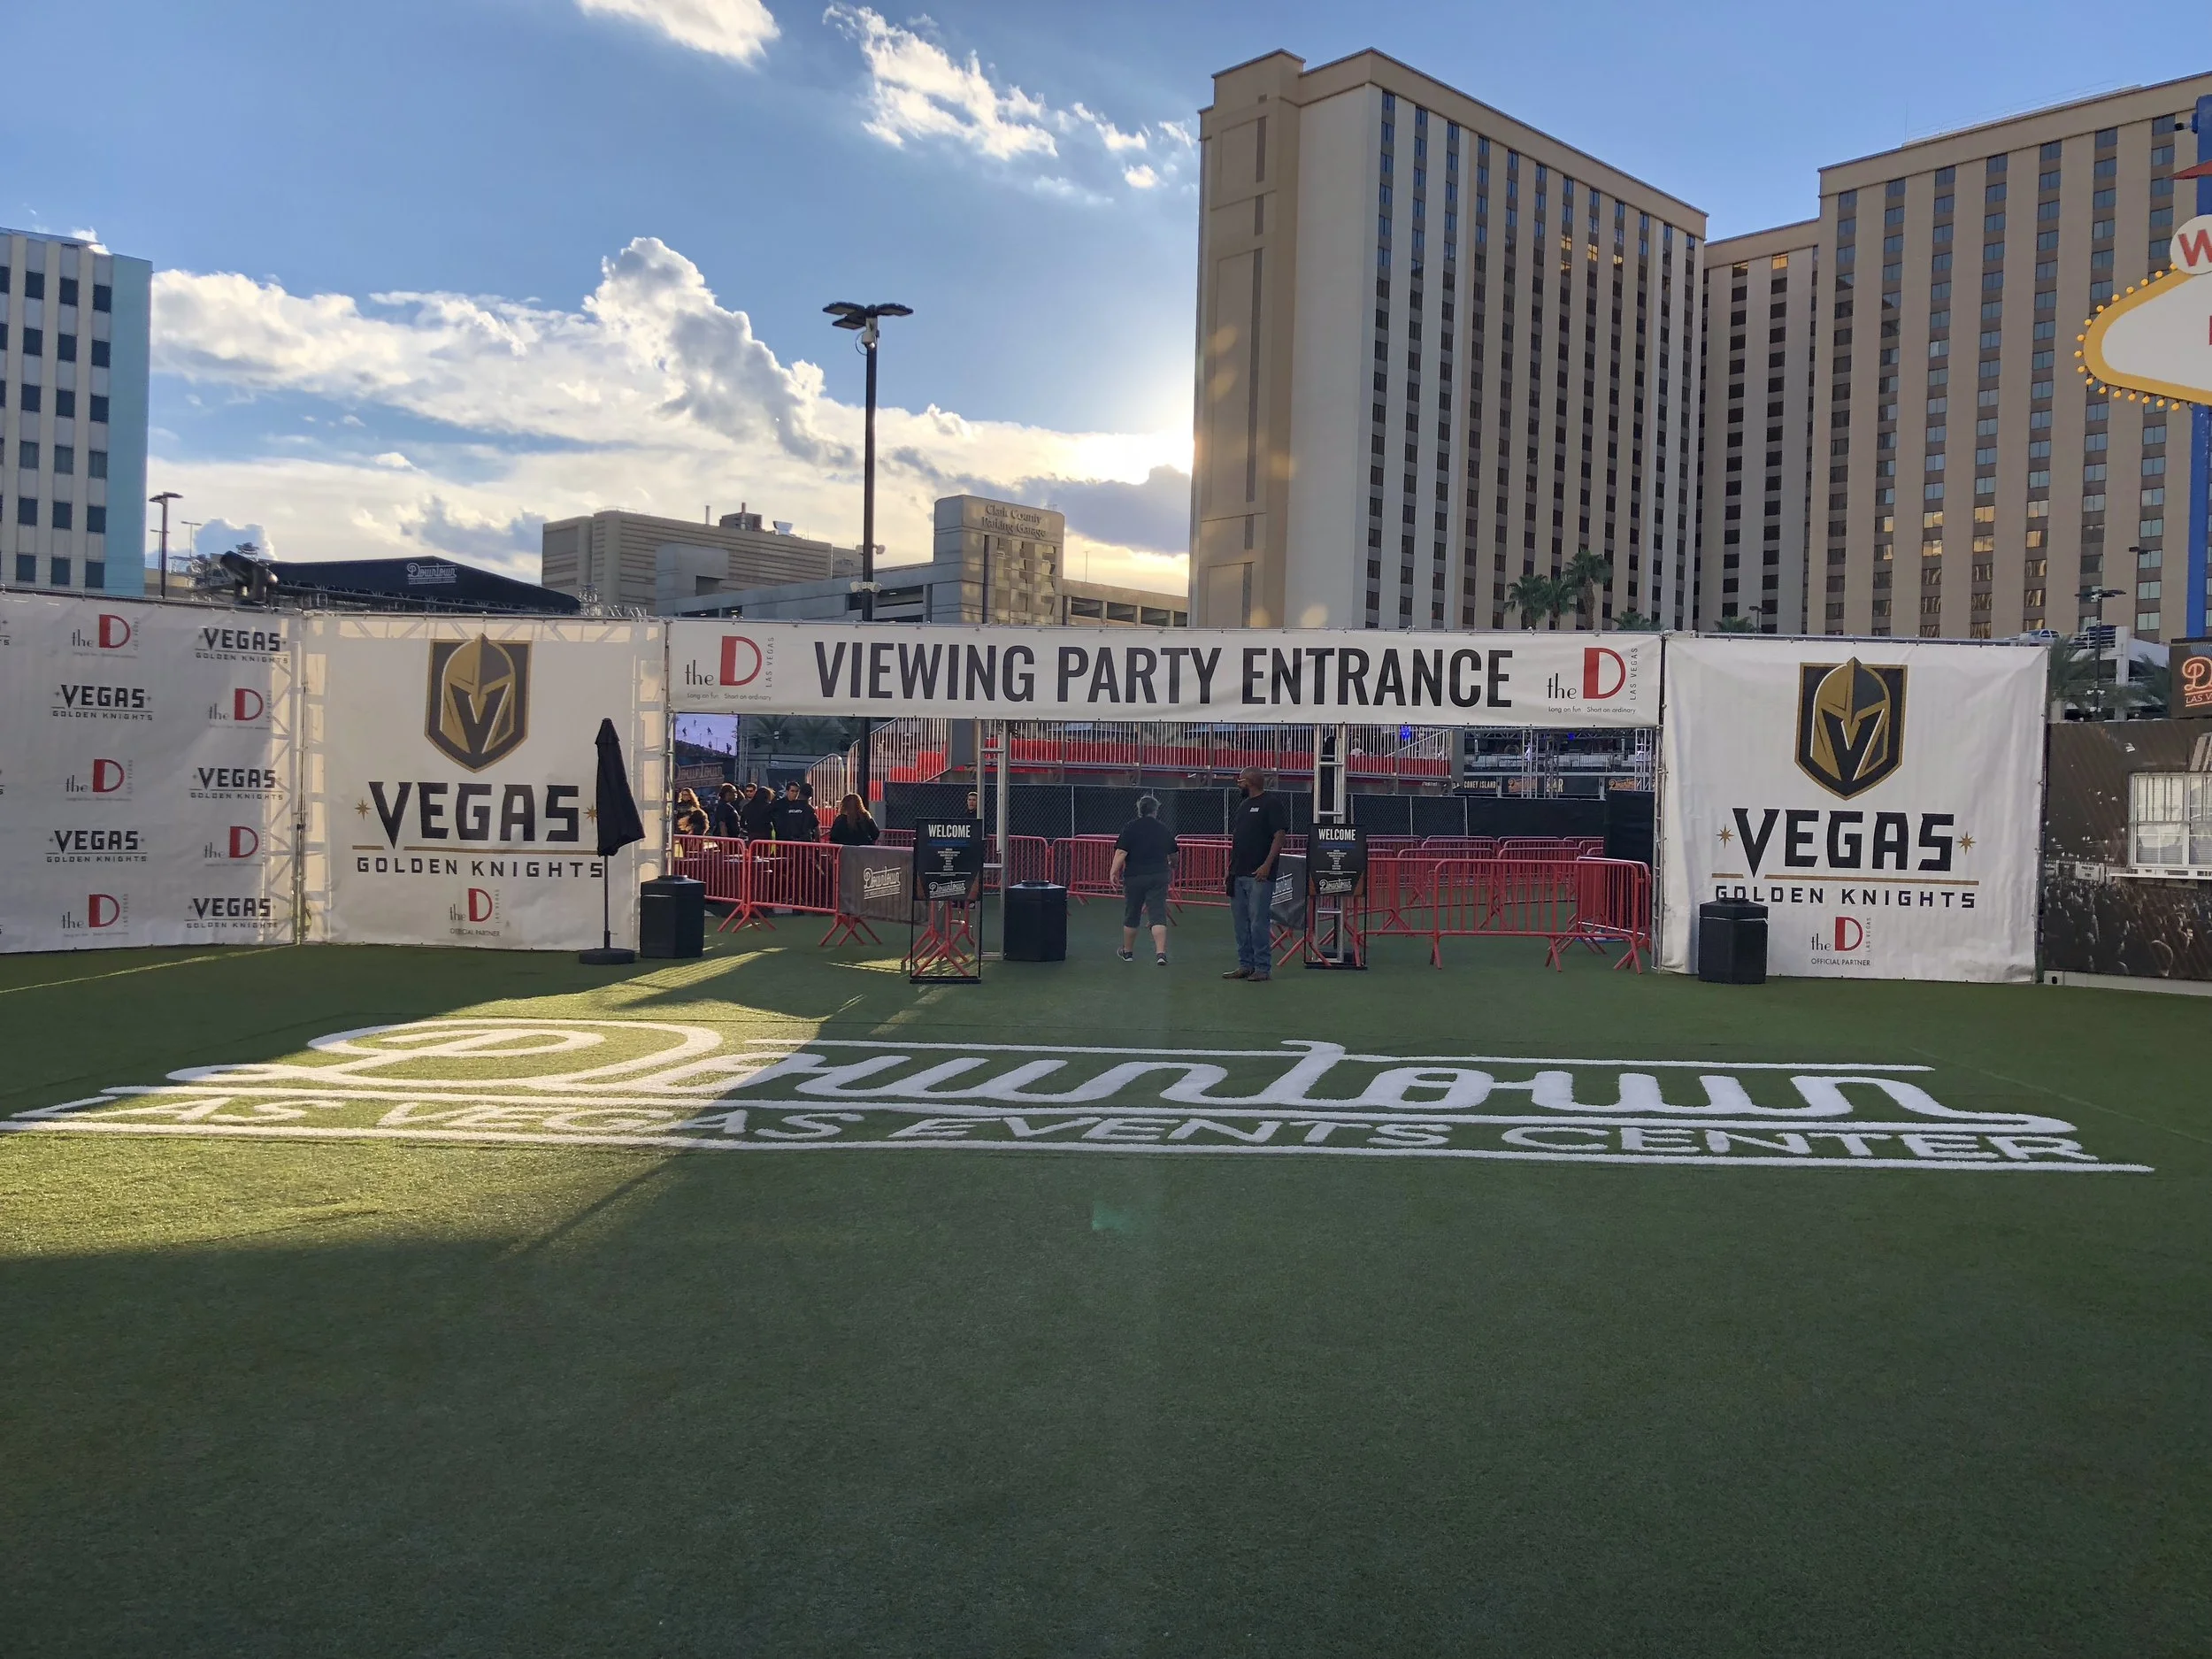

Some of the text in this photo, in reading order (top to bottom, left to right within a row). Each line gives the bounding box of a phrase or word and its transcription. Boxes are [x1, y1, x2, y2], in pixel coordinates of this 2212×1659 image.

[986, 503, 1041, 524] Clark County
[982, 517, 1046, 538] Parking Garage
[407, 563, 457, 577] Downtown
[72, 614, 131, 648] the D
[204, 628, 280, 651] VEGAS
[684, 636, 762, 686] the D
[815, 641, 1513, 707] VIEWING PARTY ENTRANCE
[1547, 648, 1625, 699] the D
[61, 685, 145, 708] VEGAS
[209, 688, 264, 720] the D
[2186, 695, 2203, 703] LAS
[103, 712, 152, 721] KNIGHTS
[65, 759, 125, 793] the D
[197, 768, 276, 789] VEGAS
[368, 781, 579, 849] VEGAS
[54, 830, 138, 854] VEGAS
[229, 826, 259, 858] D
[928, 825, 971, 837] WELCOME
[1318, 829, 1356, 841] WELCOME
[1732, 809, 1954, 878] VEGAS
[357, 857, 603, 878] GOLDEN KNIGHTS
[864, 866, 901, 889] Downtown
[193, 898, 271, 919] VEGAS
[449, 888, 493, 922] the D
[1716, 886, 1975, 908] GOLDEN KNIGHTS
[61, 894, 120, 929] the D
[1811, 917, 1863, 951] the D
[166, 1018, 2077, 1133] Downtown
[11, 1094, 2099, 1161] LAS VEGAS EVENTS CENTER
